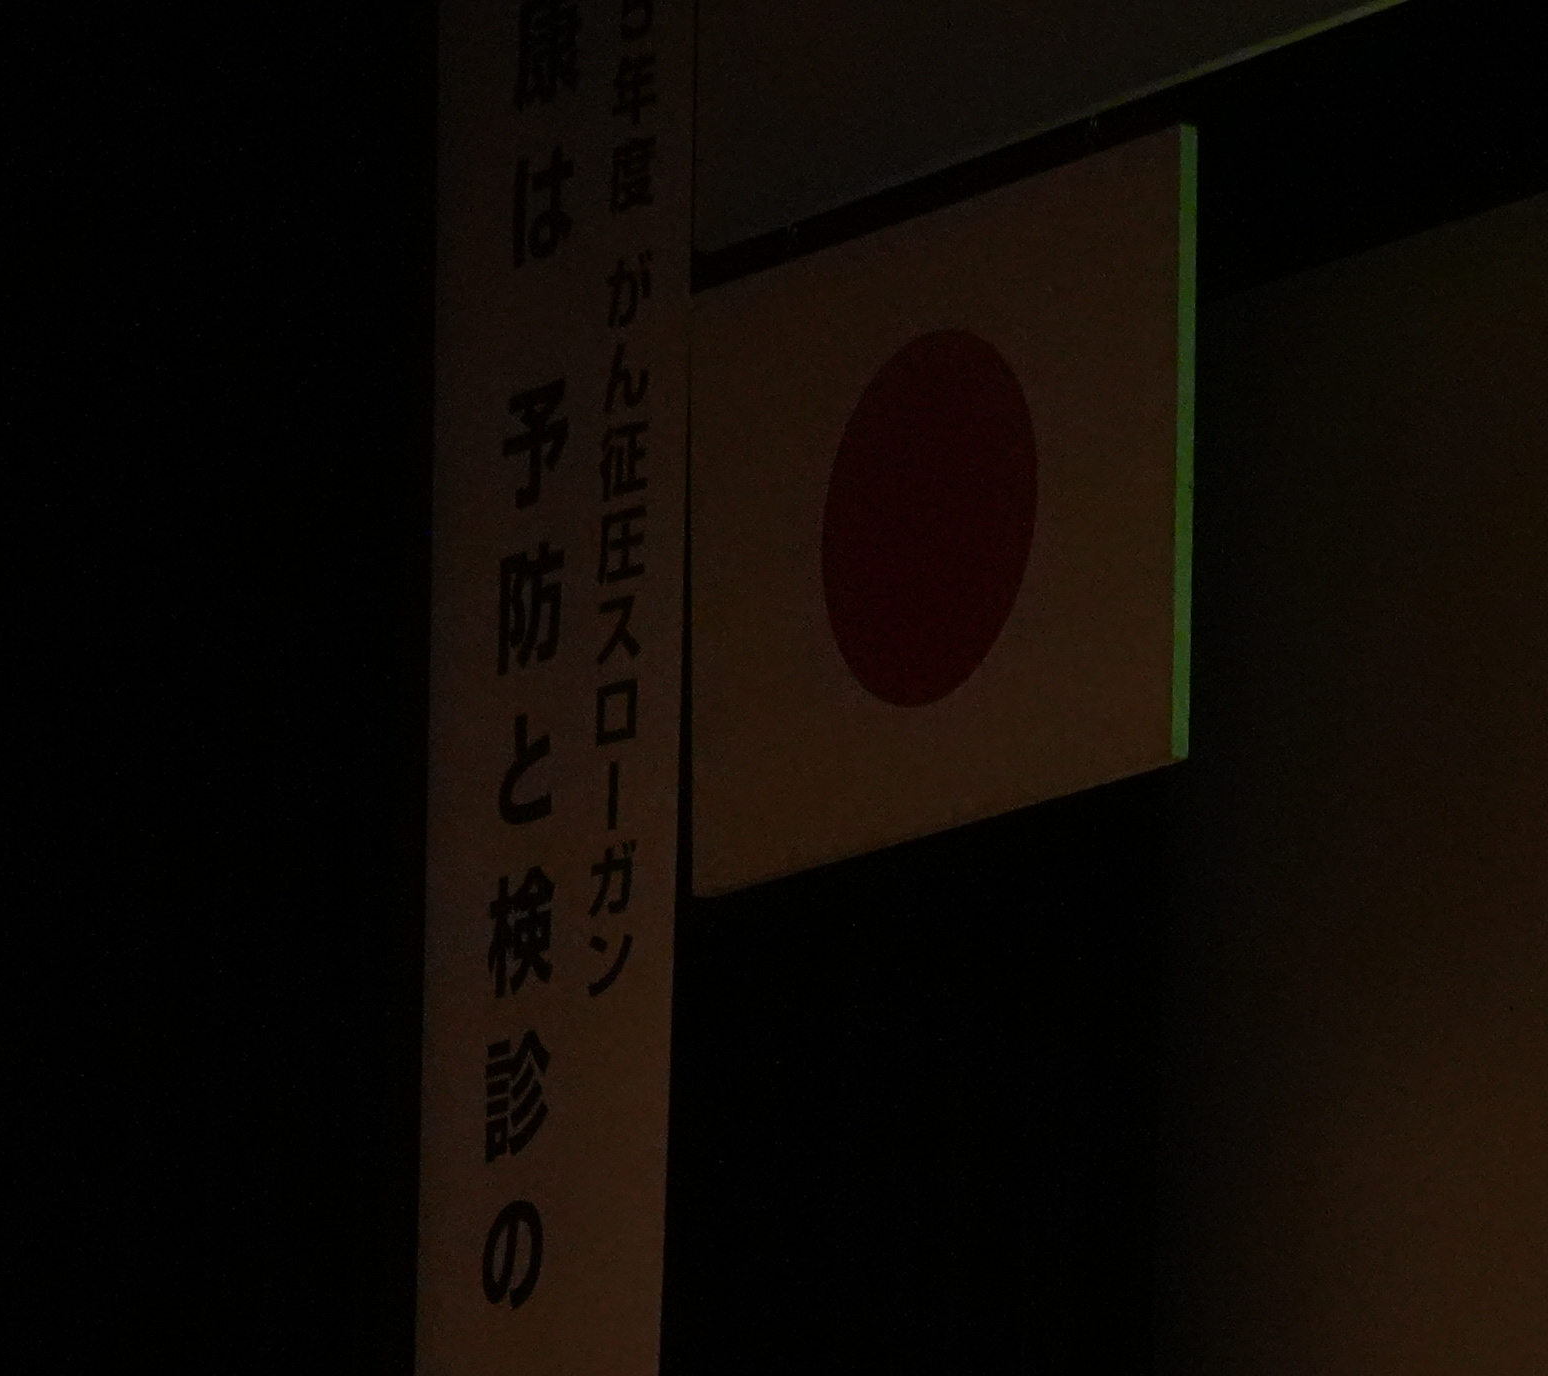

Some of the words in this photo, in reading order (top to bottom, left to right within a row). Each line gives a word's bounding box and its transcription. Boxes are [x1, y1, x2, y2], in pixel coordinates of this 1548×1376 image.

[482, 378, 569, 1310] 予防と検診の
